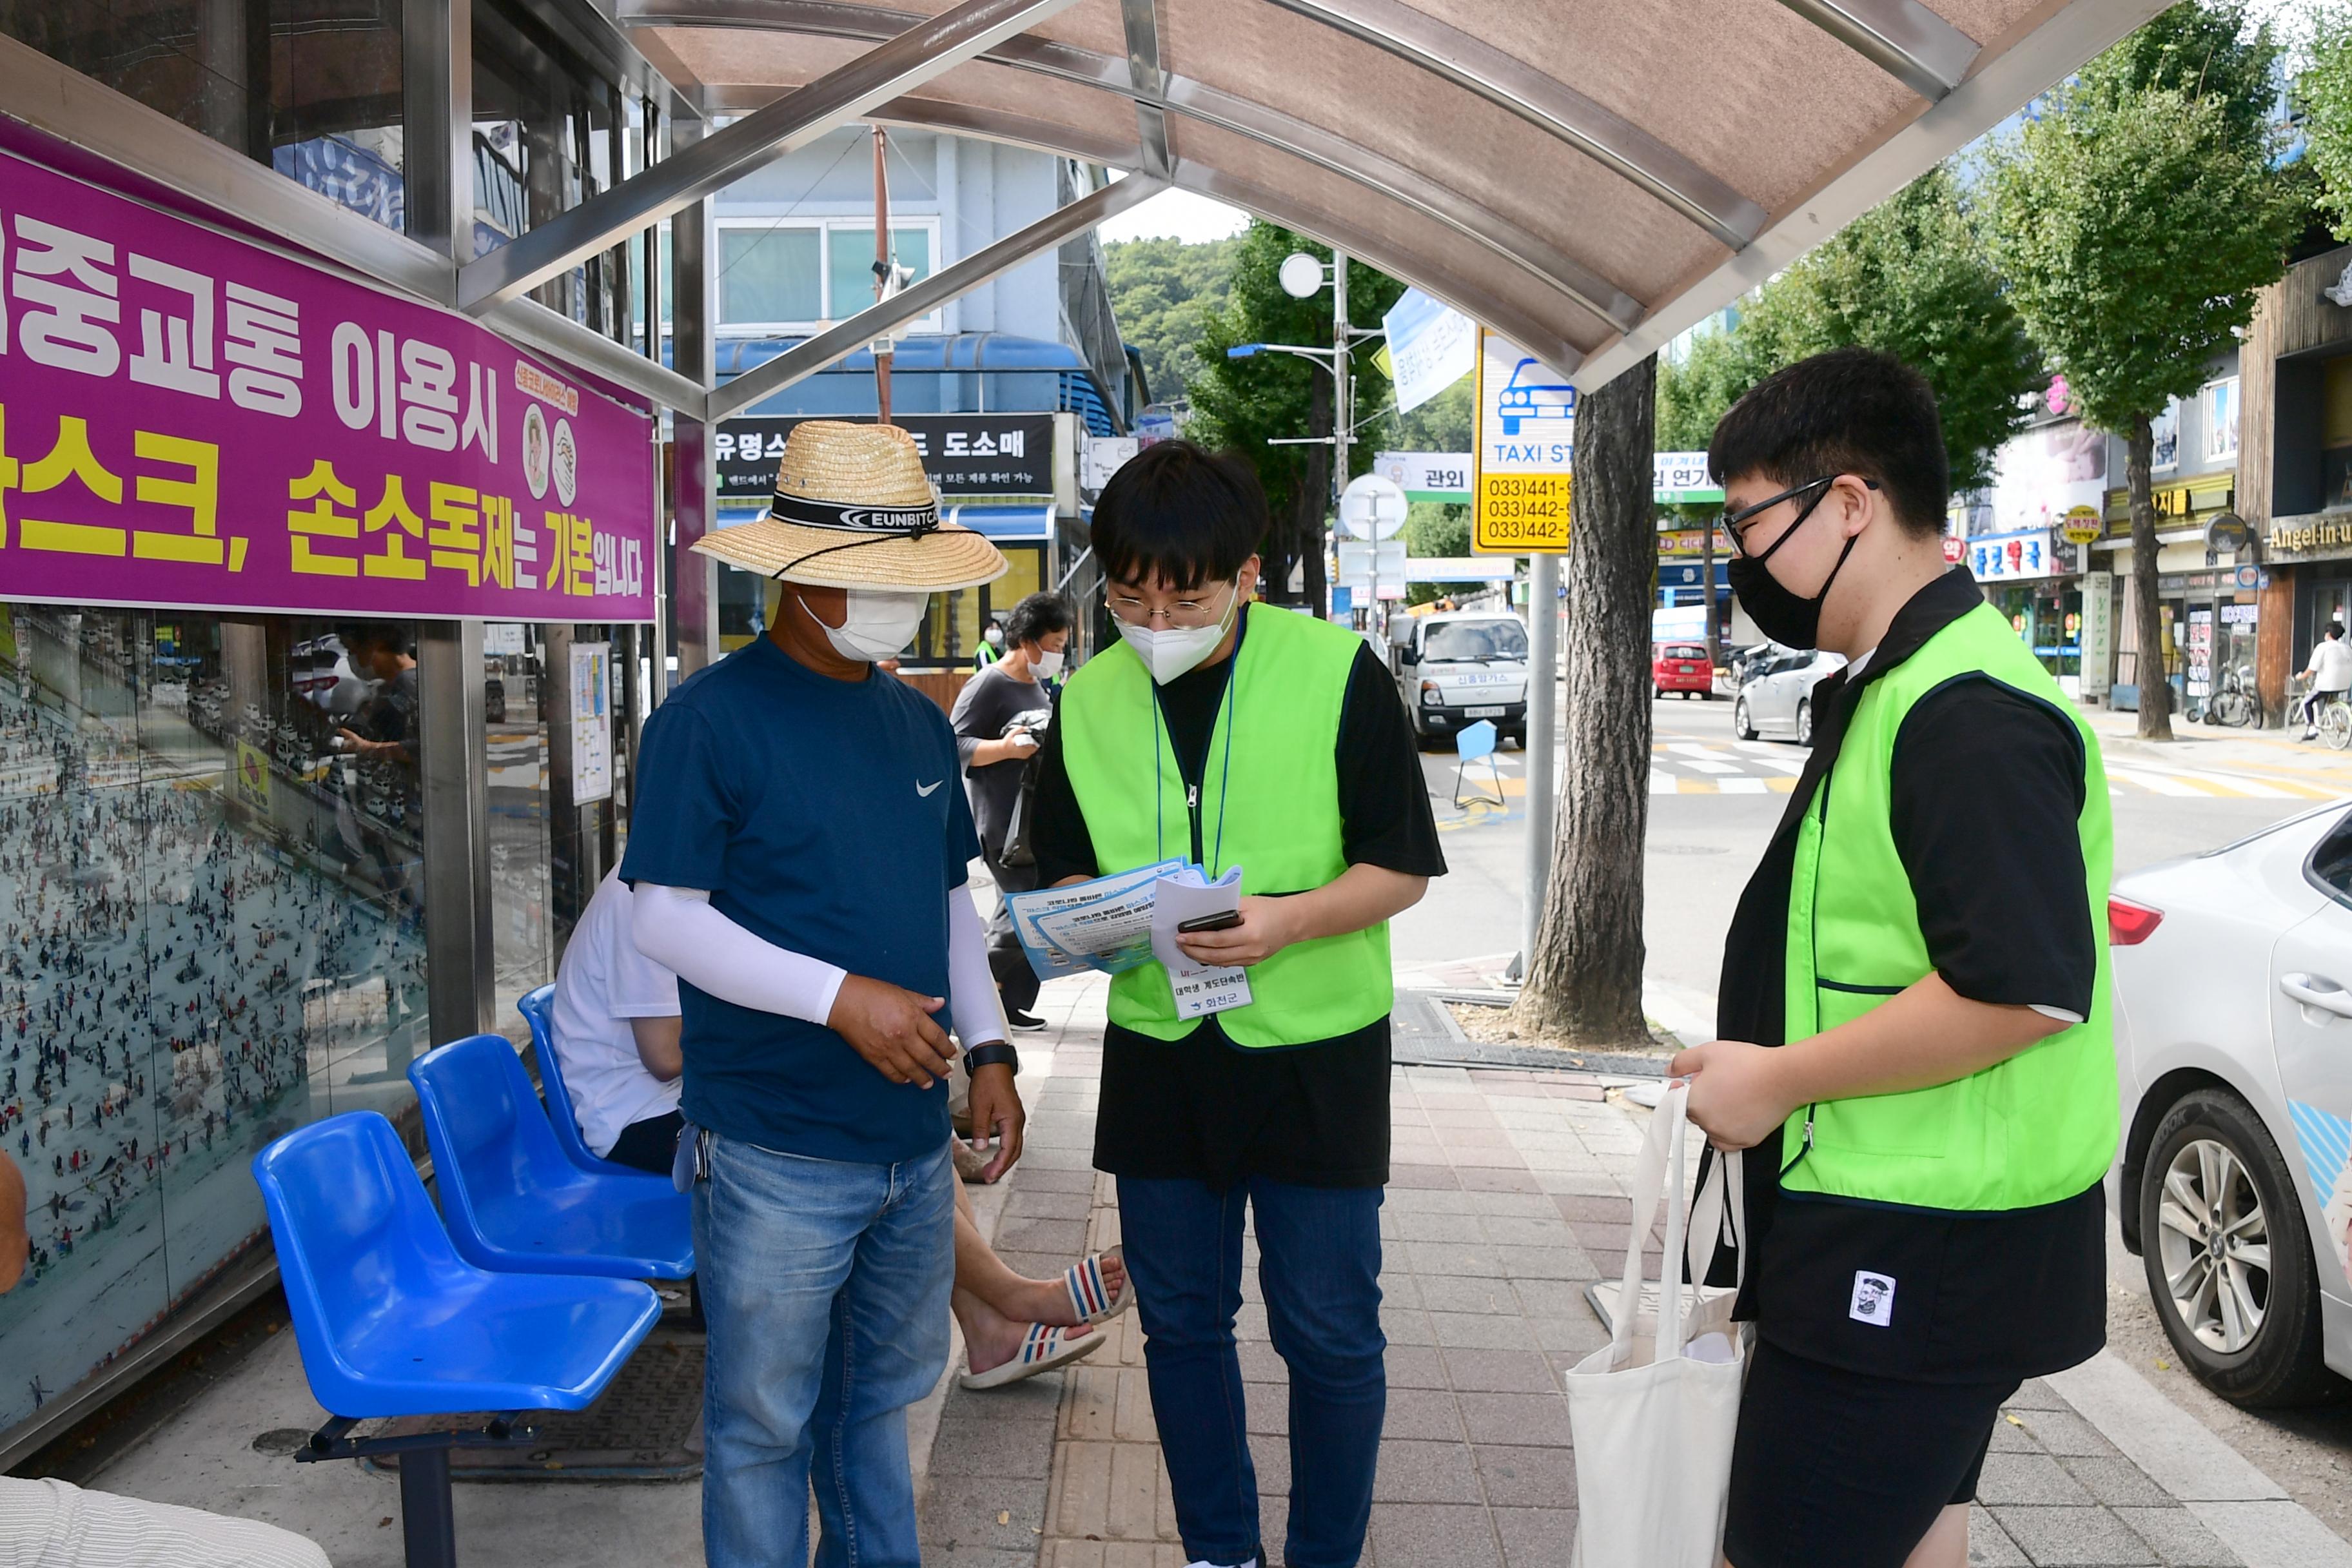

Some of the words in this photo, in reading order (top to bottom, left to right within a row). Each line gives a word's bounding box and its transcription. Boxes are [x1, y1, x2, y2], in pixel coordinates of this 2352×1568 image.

[0, 209, 304, 418] 중교통
[331, 320, 498, 464] 이용시
[943, 429, 1024, 458] 도소매
[1494, 445, 1541, 462] TAXI
[1551, 445, 1574, 462] ST
[1661, 456, 1707, 466] 이겨내
[946, 473, 965, 484] 모든
[968, 473, 988, 484] 제품
[991, 473, 1010, 484] 확인
[1013, 472, 1034, 484] 가능
[1426, 470, 1464, 488] 관외
[1673, 470, 1710, 487] 연기
[1490, 479, 1571, 497] 033)441-
[1489, 500, 1570, 518] 033)442-
[287, 459, 537, 590] 손소독제는
[545, 511, 643, 599] 기본입니다
[1489, 520, 1569, 539] 033)442-
[1126, 896, 1148, 908] 마스크
[1175, 983, 1200, 997] 대학생
[1204, 973, 1245, 990] 계도단속반
[1206, 993, 1239, 1008] 화천군
